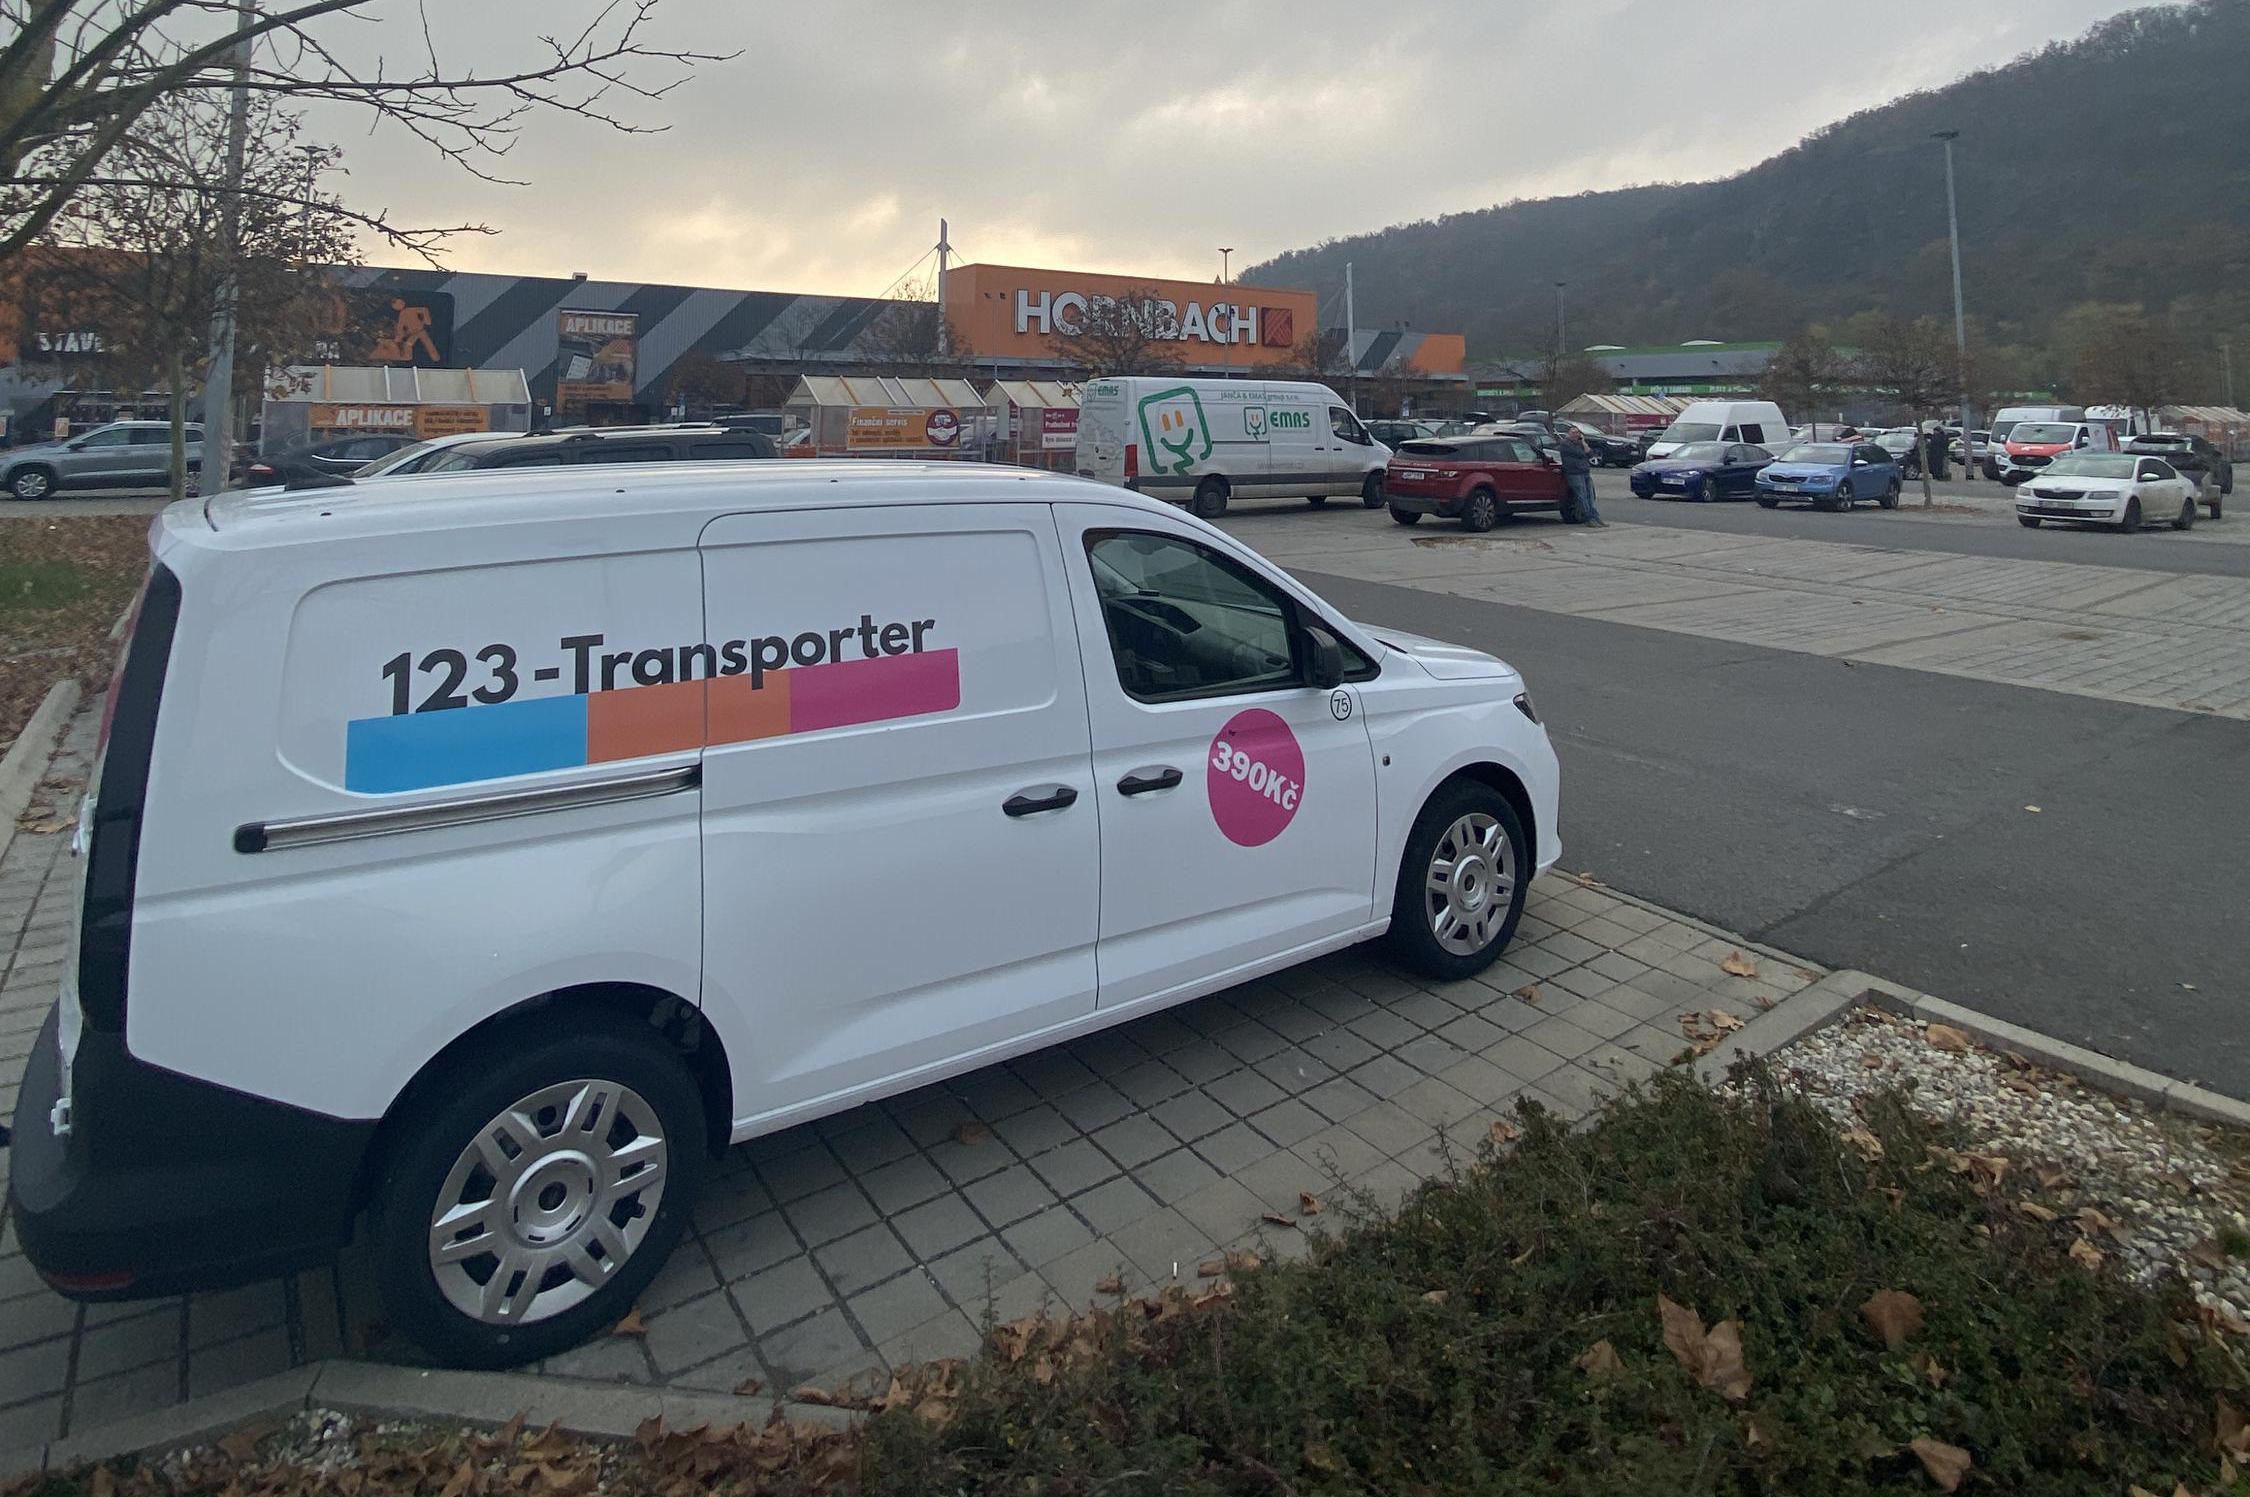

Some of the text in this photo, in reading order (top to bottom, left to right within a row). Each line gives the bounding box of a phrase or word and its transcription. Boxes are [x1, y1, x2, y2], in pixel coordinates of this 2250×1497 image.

[566, 316, 633, 335] APLIKACE
[1015, 288, 1257, 345] HORNBACH
[335, 409, 413, 426] APLIKACE
[1270, 411, 1310, 428] EMAS
[1334, 698, 1349, 714] 75
[1212, 741, 1300, 811] 390Kč
